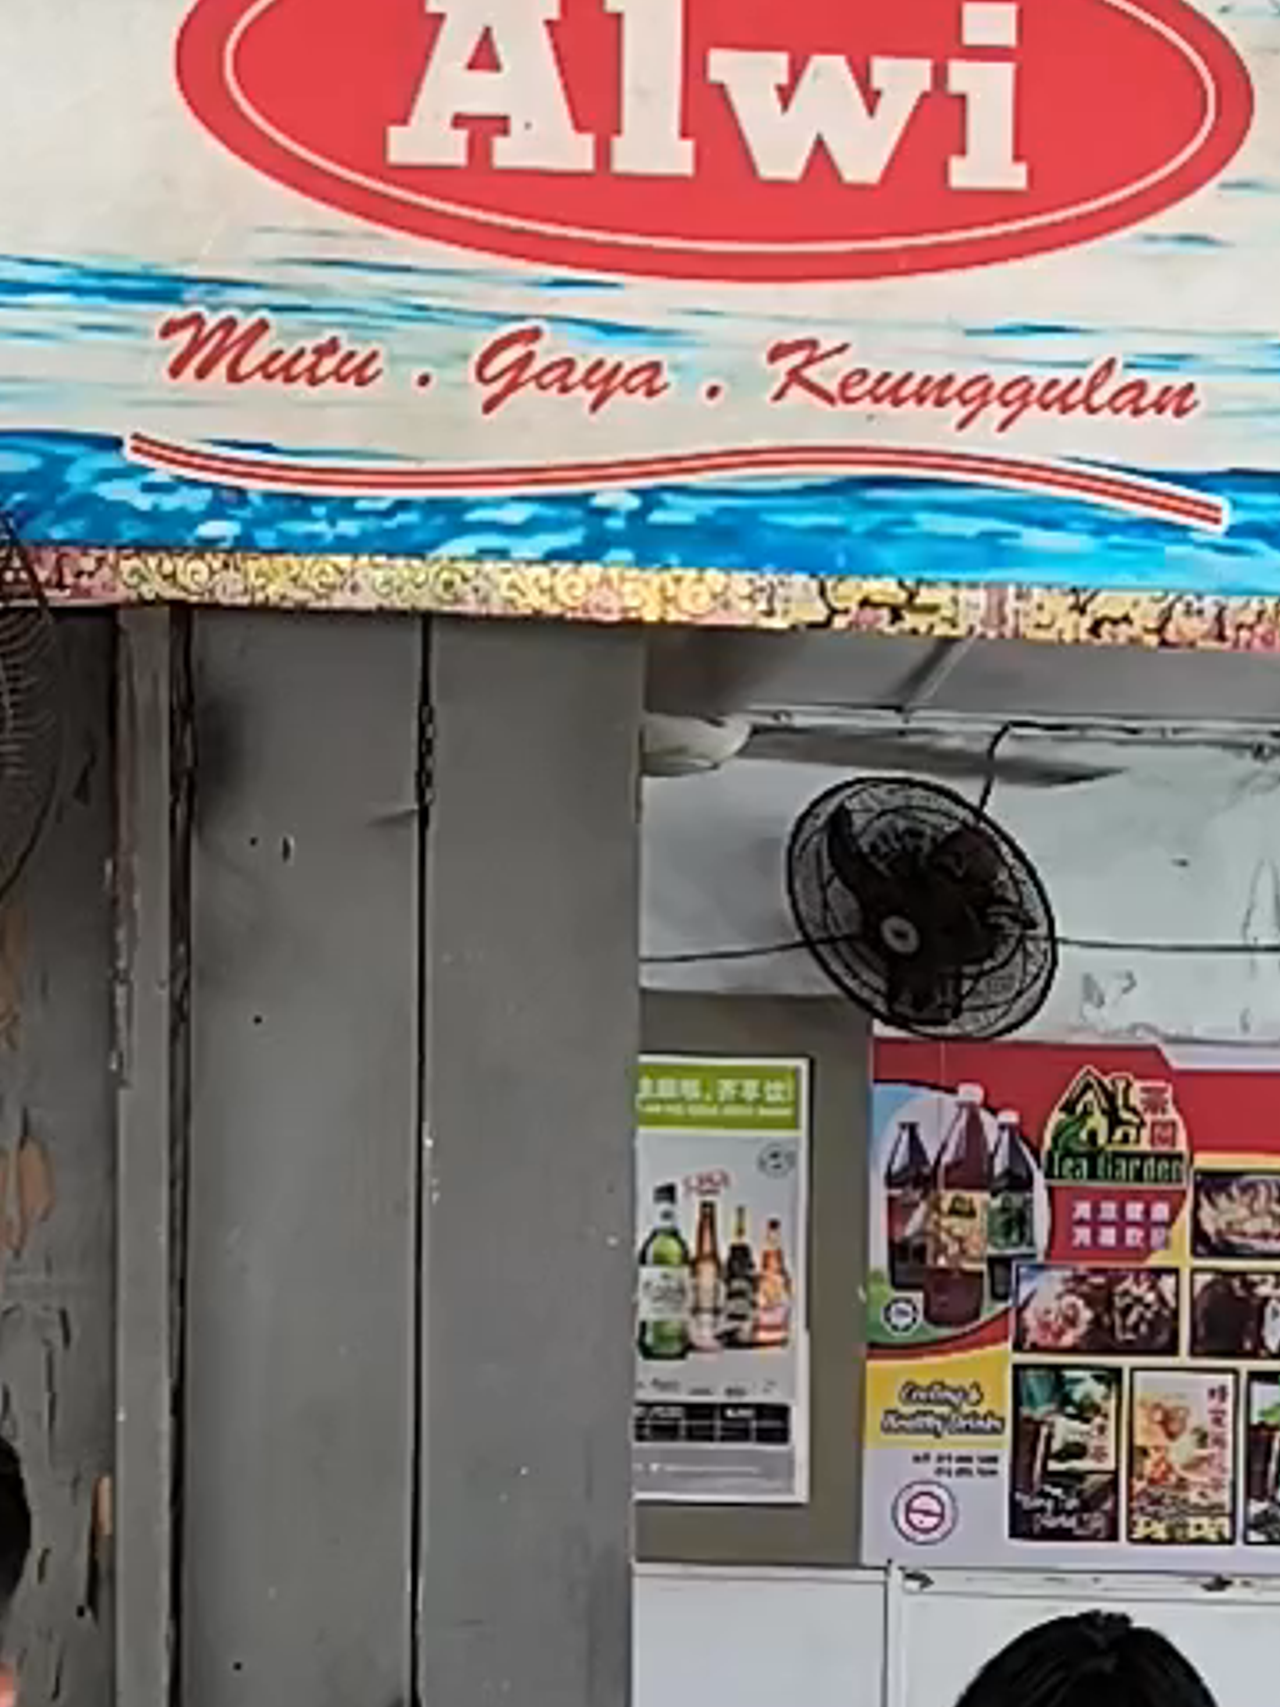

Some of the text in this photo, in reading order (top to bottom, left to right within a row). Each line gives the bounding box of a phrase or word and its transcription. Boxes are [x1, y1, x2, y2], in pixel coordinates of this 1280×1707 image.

[158, 312, 382, 385] Mutu
[473, 328, 668, 415] Gaya
[766, 337, 1201, 432] Keunggulan
[1051, 1151, 1182, 1180] Tea Garden
